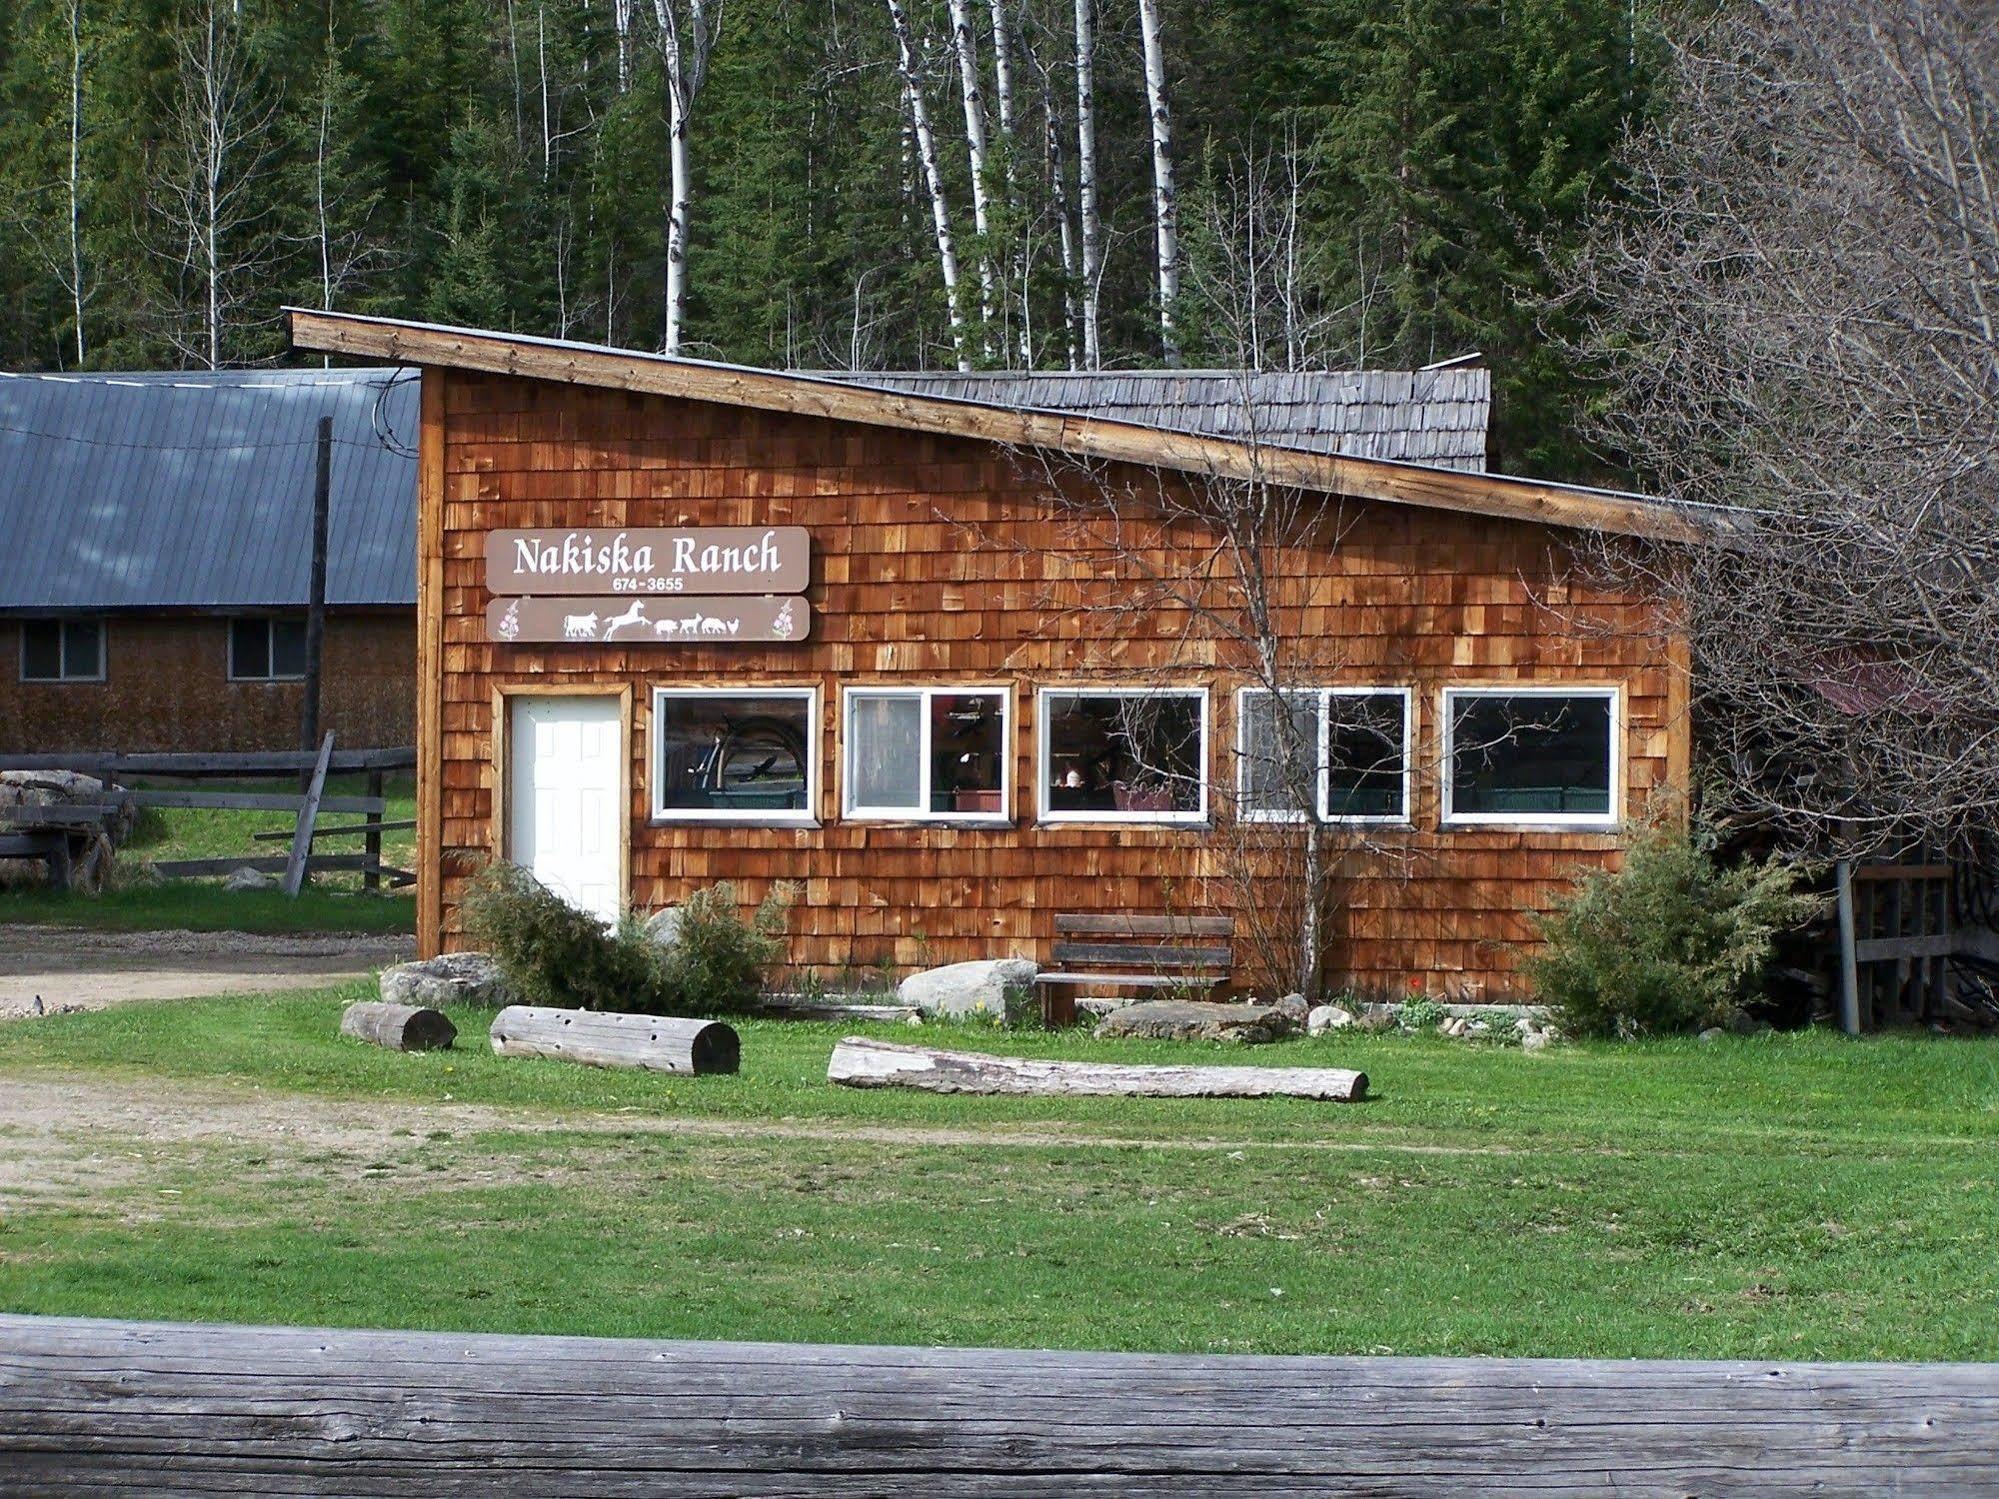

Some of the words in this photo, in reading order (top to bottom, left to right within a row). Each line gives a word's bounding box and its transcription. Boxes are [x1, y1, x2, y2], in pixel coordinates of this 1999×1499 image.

[513, 532, 655, 574] Nakiska
[672, 530, 782, 574] Ranch
[612, 577, 684, 592] 674-3655
